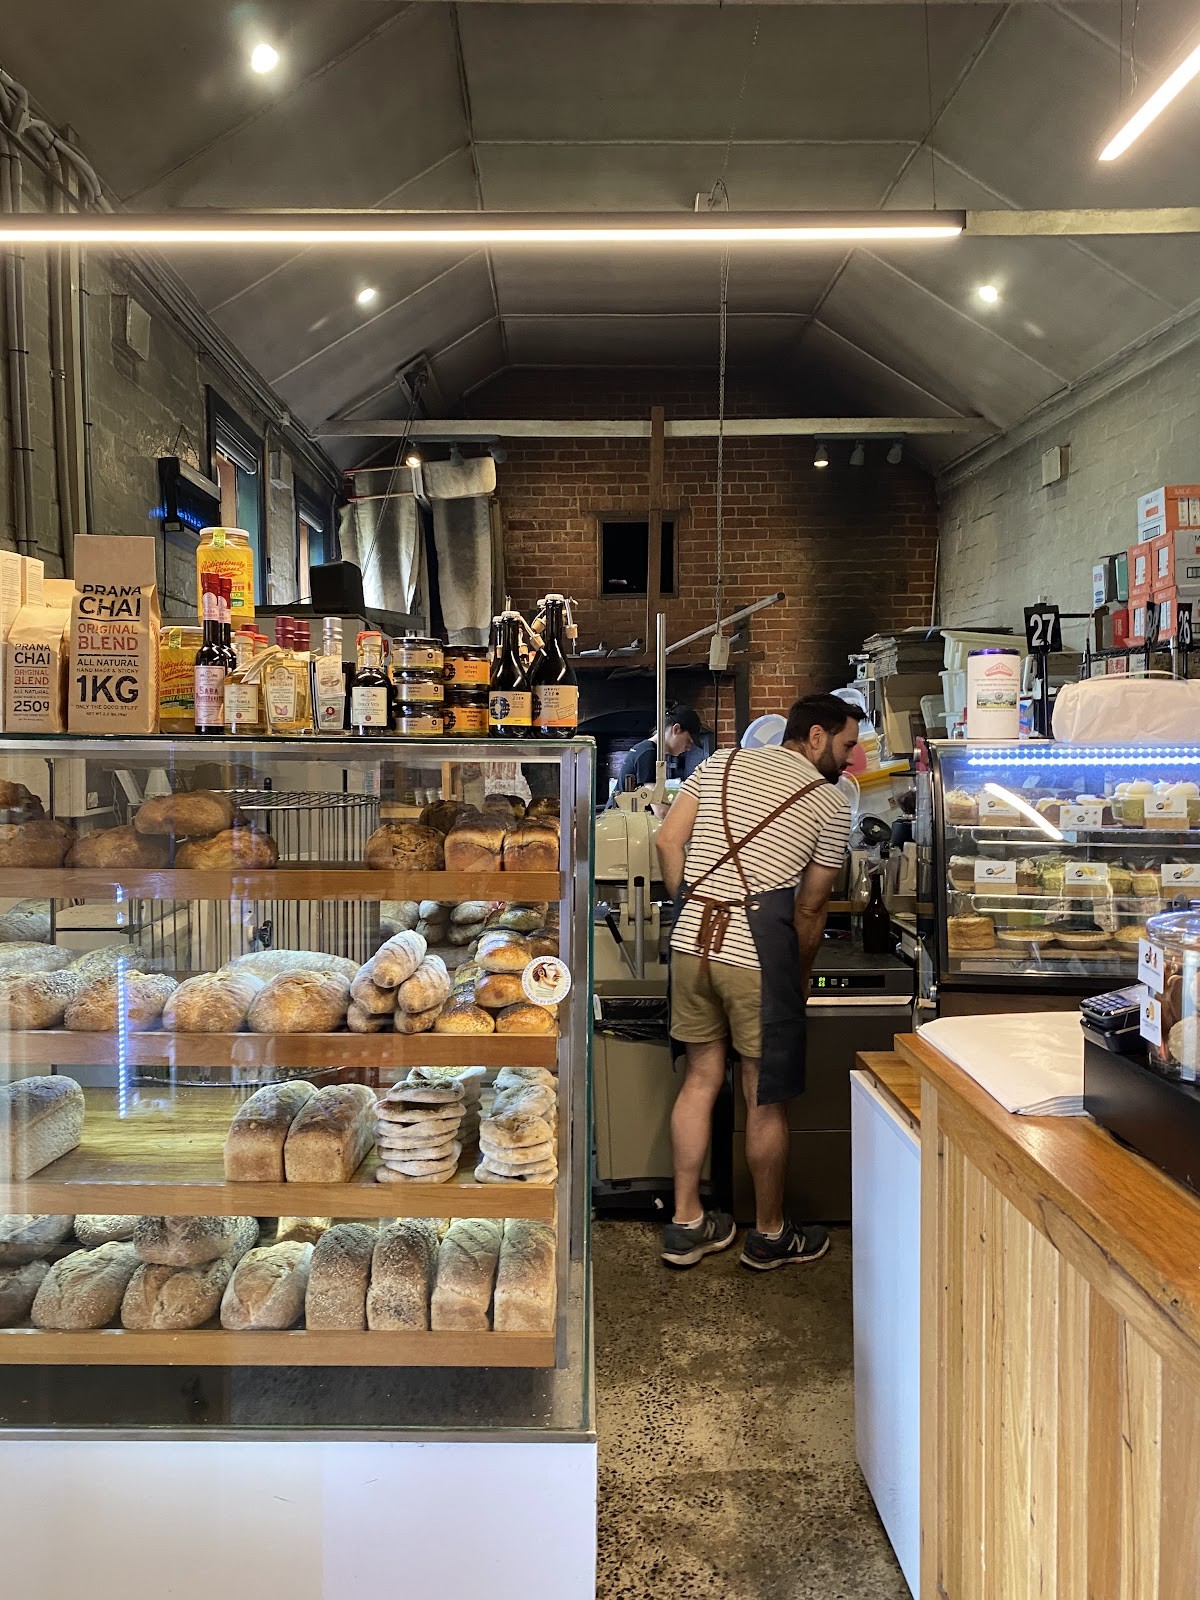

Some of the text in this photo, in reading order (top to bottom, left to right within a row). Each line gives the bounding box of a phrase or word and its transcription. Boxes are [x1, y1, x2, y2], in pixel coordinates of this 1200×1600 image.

[82, 584, 142, 597] PRANA
[79, 596, 141, 617] CHAI
[78, 623, 138, 635] ORIGINAL
[1029, 613, 1055, 647] 27
[1178, 610, 1191, 645] 26
[14, 643, 51, 651] PRANA
[78, 635, 139, 651] BLEND
[14, 652, 50, 665] CHAI
[77, 658, 139, 667] ALL NATURAL
[14, 676, 49, 685] BLEND
[76, 675, 139, 704] 1KG
[13, 700, 50, 712] 250g
